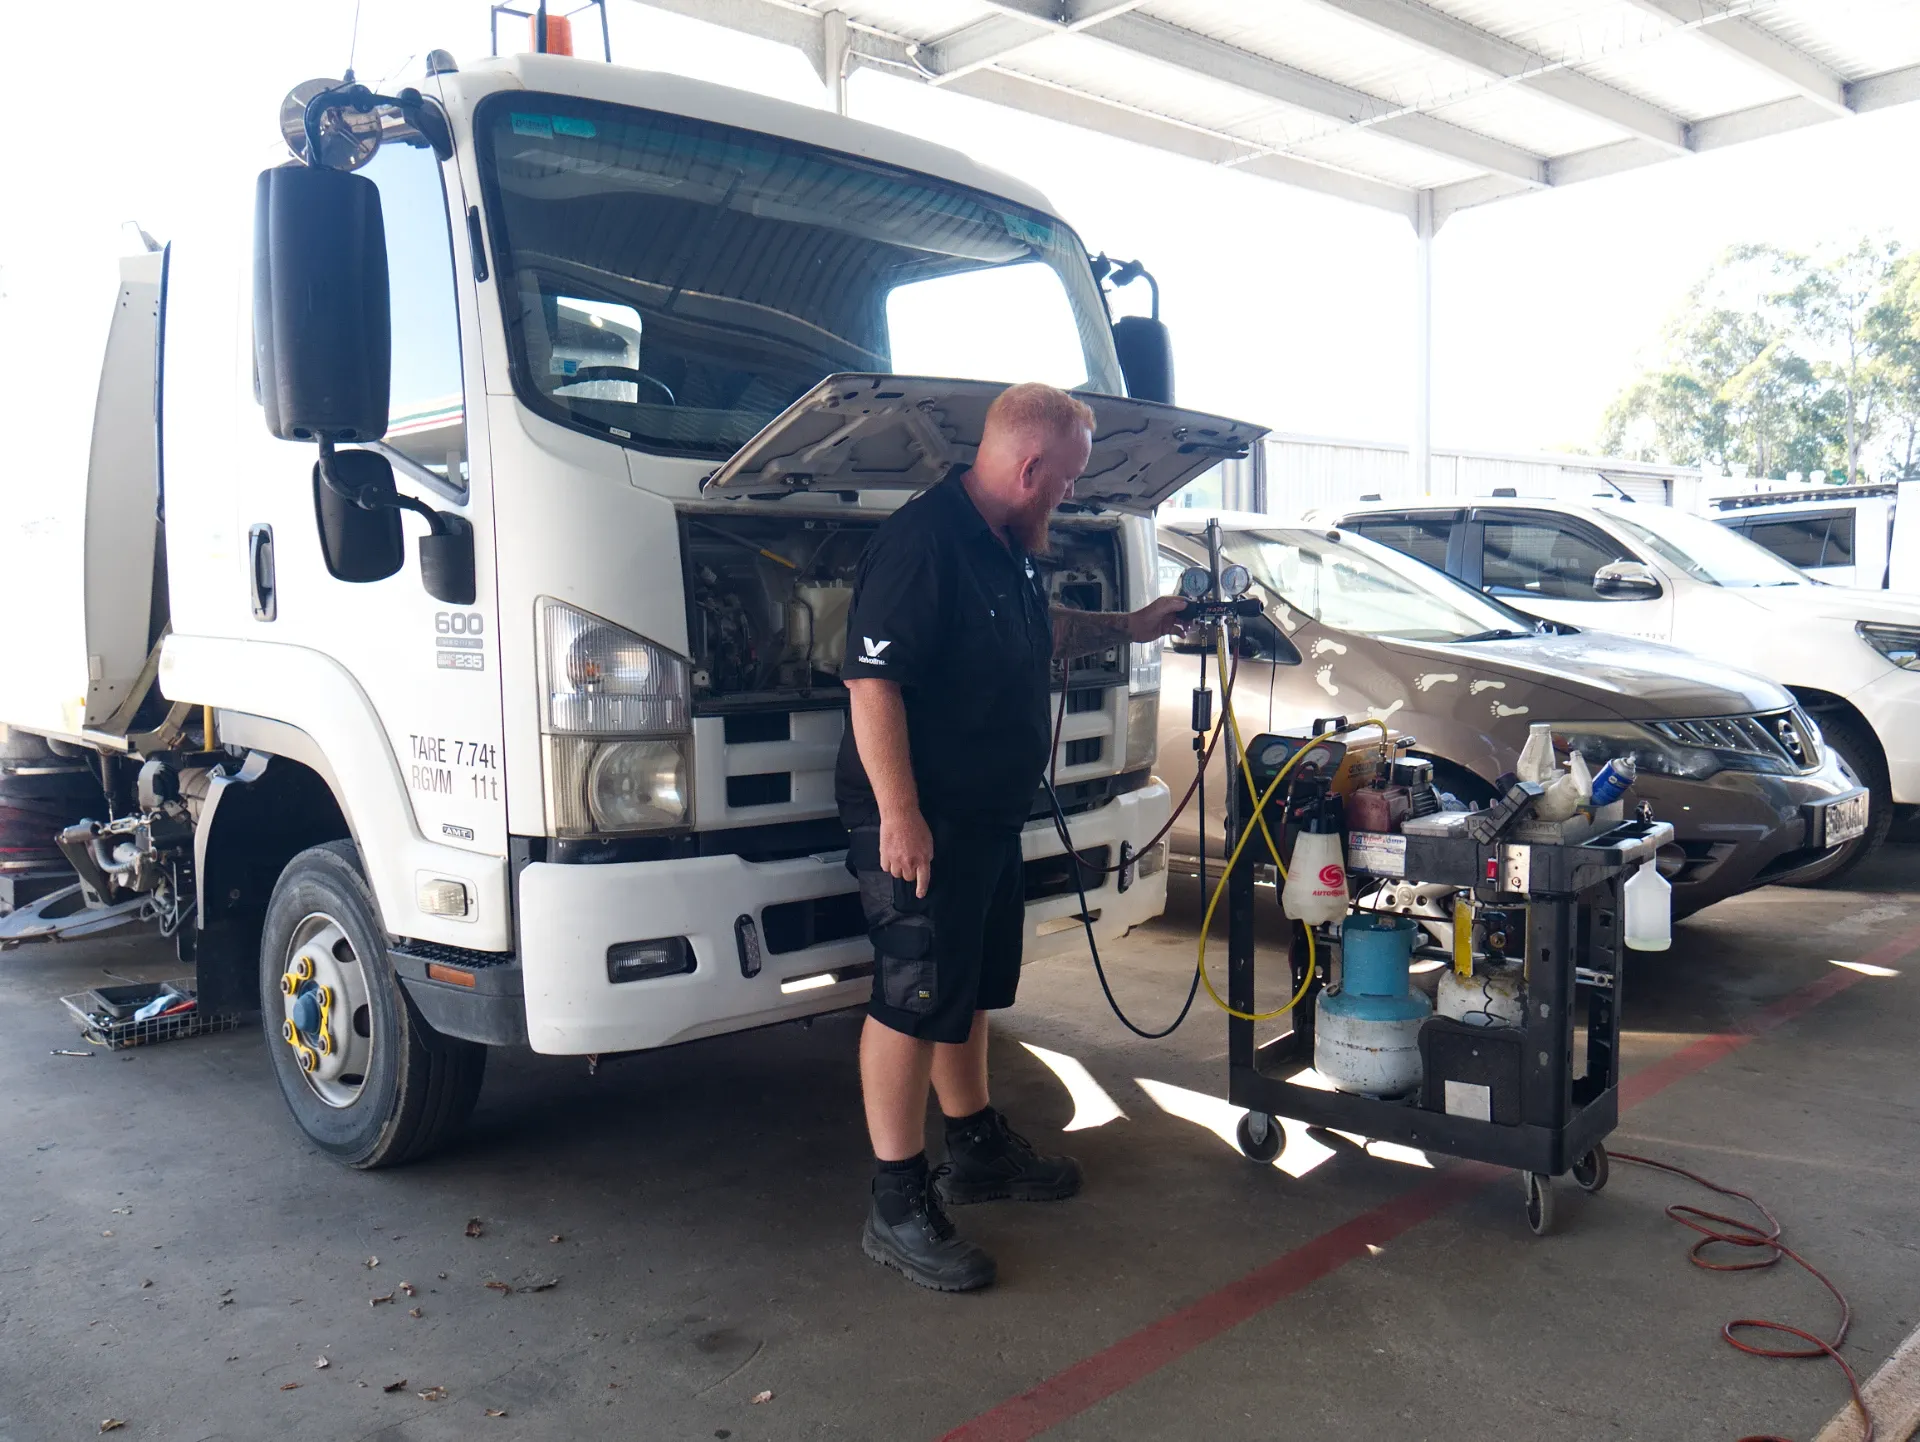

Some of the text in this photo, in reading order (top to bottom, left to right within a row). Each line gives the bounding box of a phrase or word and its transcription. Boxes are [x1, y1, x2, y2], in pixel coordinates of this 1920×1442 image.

[435, 611, 484, 635] 600
[456, 654, 482, 668] 235
[410, 734, 496, 770] TARE 7.74t
[411, 764, 452, 795] RGVM
[445, 826, 469, 838] AMT
